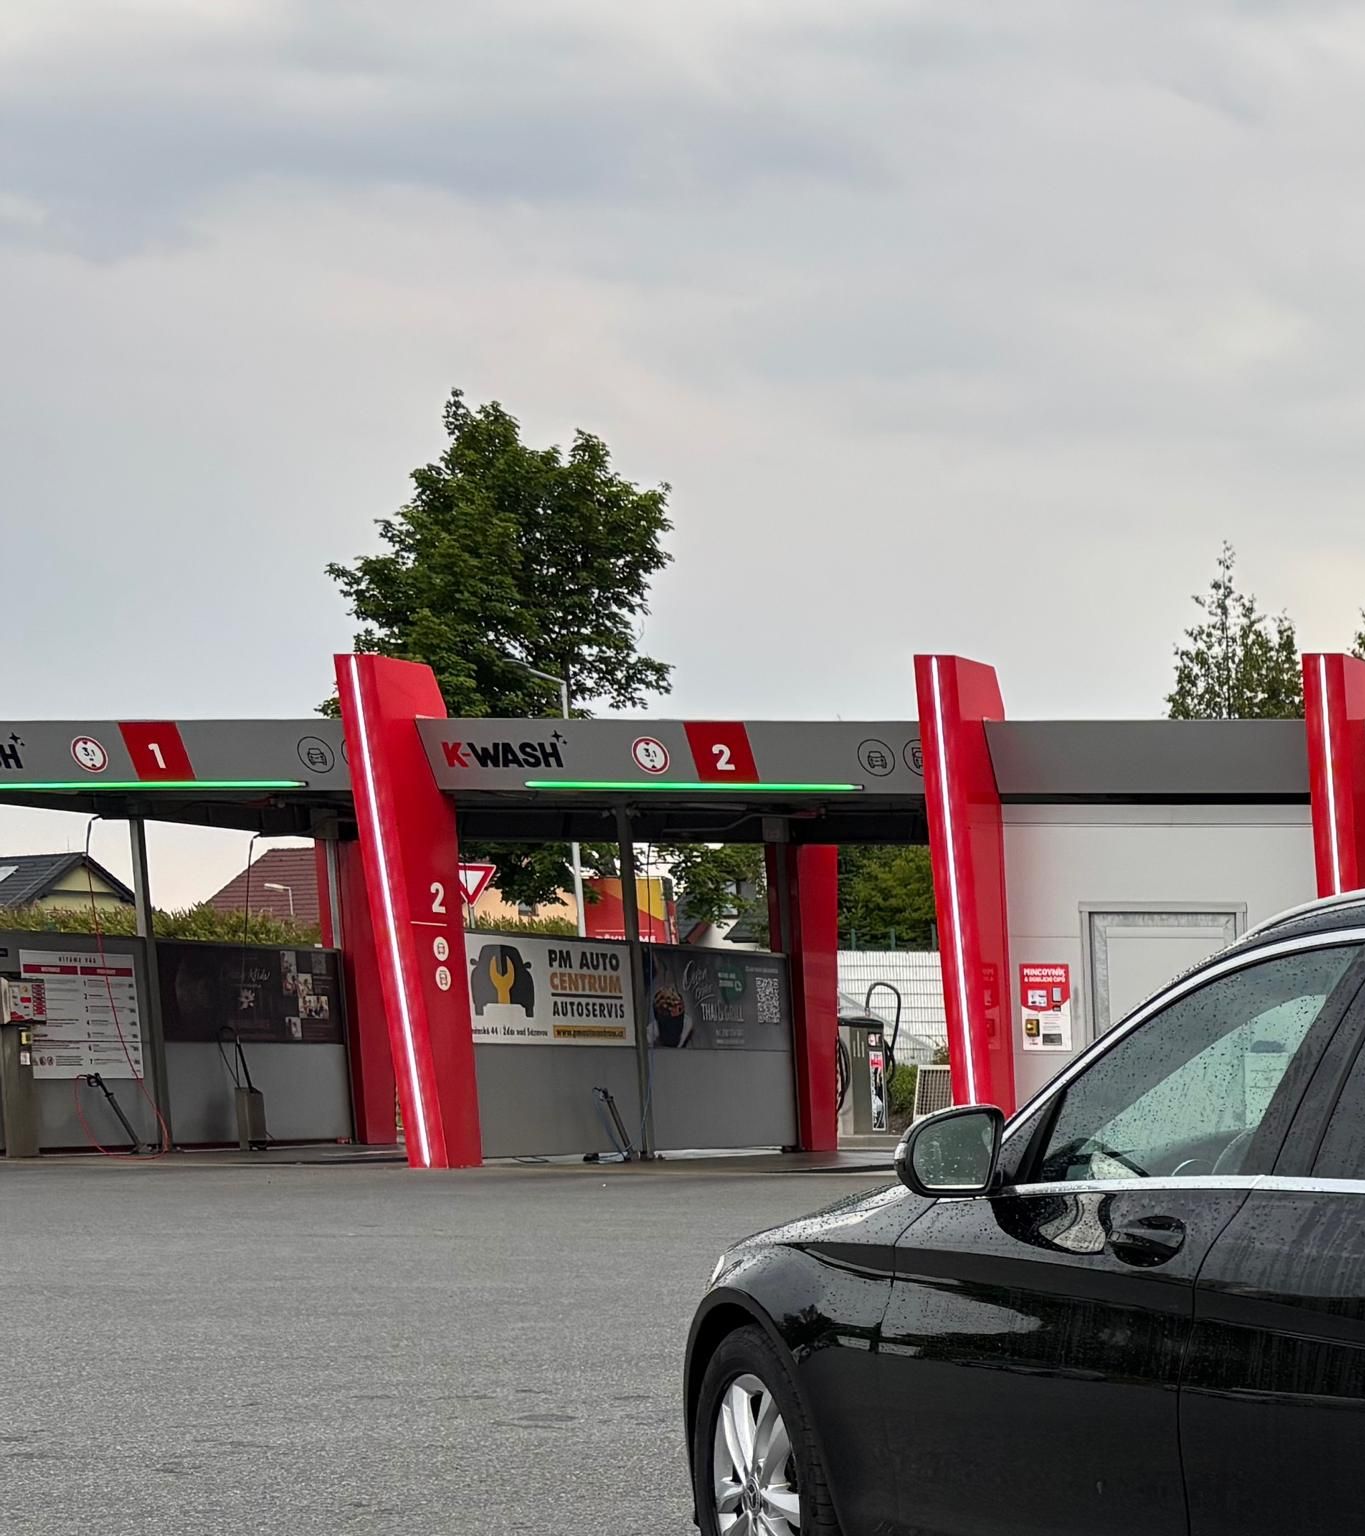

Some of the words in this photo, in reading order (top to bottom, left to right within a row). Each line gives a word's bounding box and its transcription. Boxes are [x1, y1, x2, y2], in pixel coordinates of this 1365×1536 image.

[148, 743, 167, 769] 1
[441, 742, 564, 769] K-WASH
[711, 744, 736, 771] 2
[430, 882, 446, 914] 2
[548, 949, 573, 969] PM
[579, 951, 620, 971] AUTO
[550, 971, 622, 994] CENTRUM
[552, 1001, 624, 1019] AUTOSERVIS
